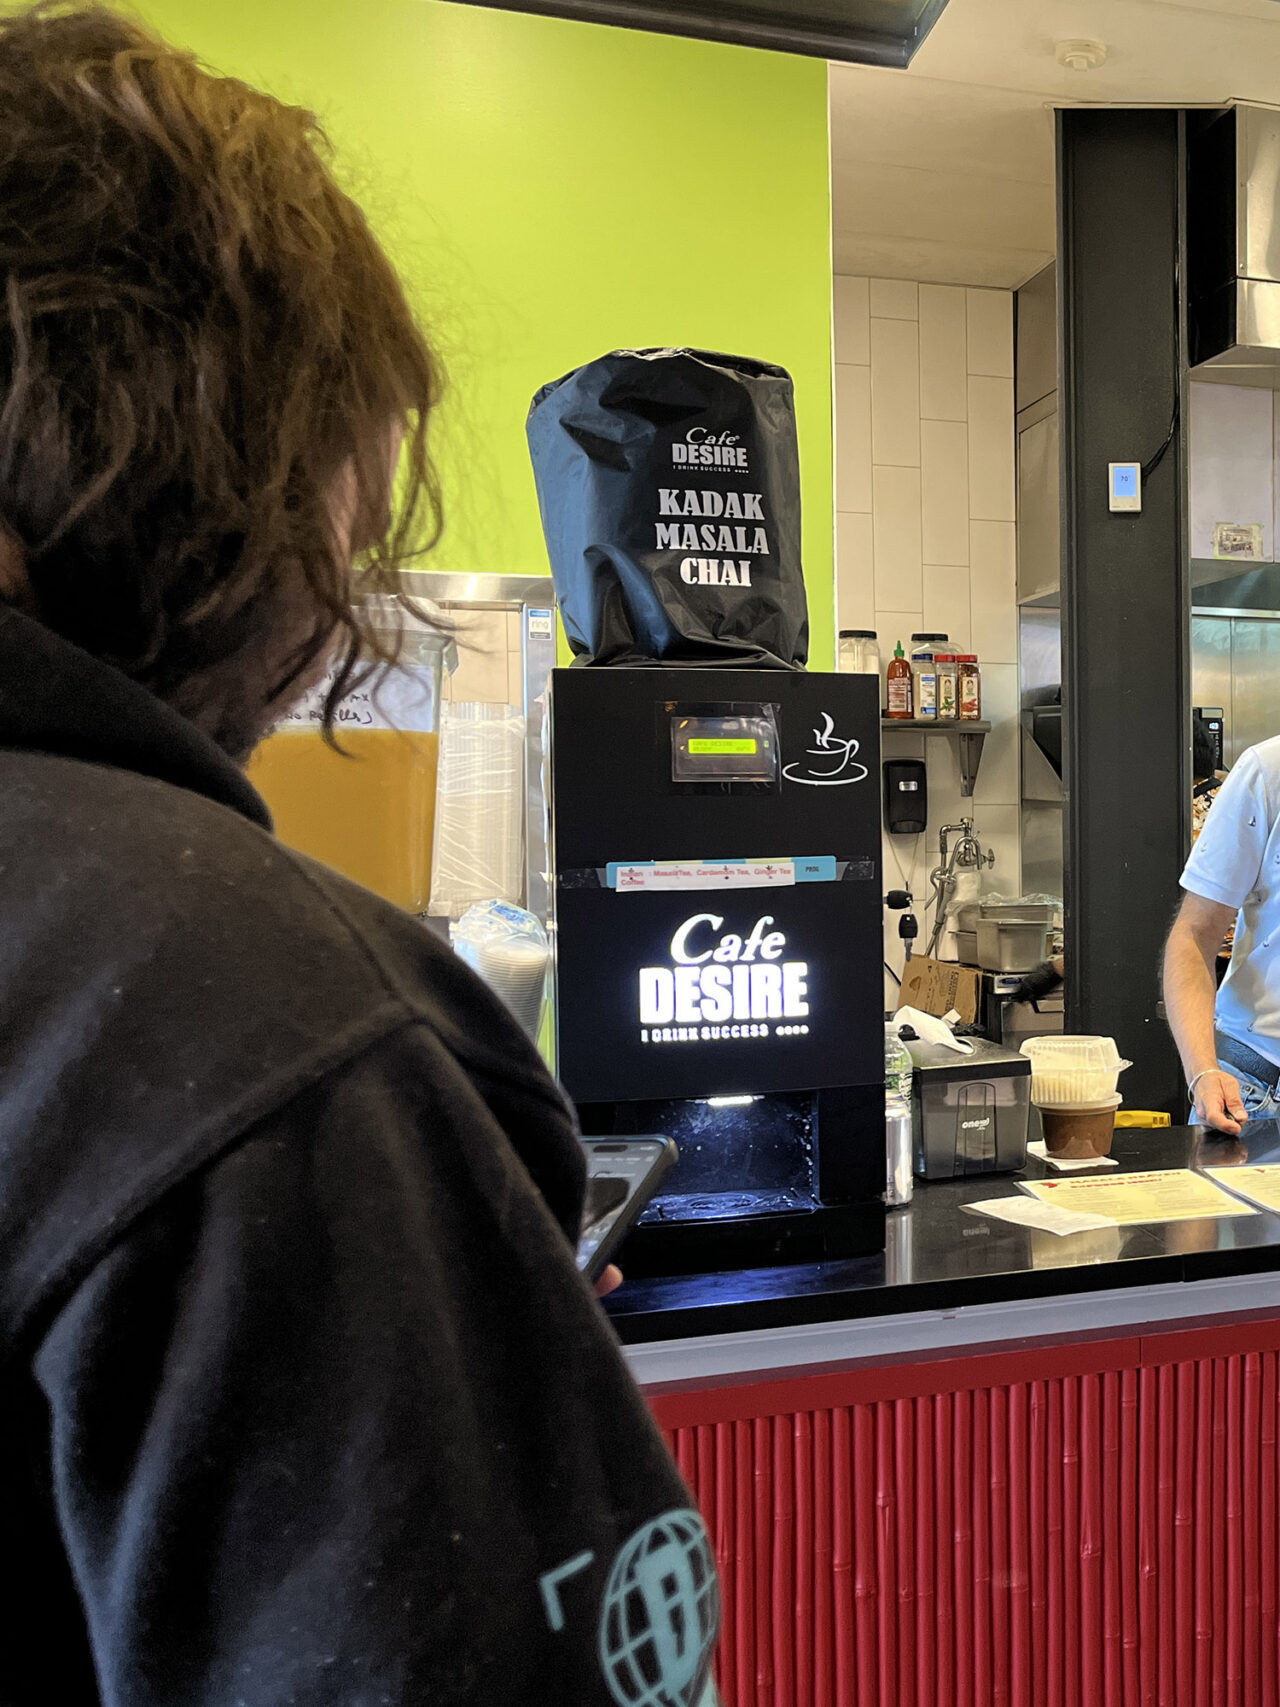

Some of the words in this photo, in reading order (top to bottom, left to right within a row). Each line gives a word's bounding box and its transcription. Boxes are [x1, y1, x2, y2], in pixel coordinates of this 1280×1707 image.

[686, 427, 737, 446] Cafe
[672, 443, 748, 467] DESIRE
[658, 488, 765, 520] KADAK
[655, 523, 770, 554] MASALA
[680, 557, 752, 587] CHAI
[670, 913, 786, 966] Cafe
[639, 962, 810, 1024] DESIRE
[651, 1026, 699, 1043] DRINK
[701, 1023, 770, 1041] SUCCESS
